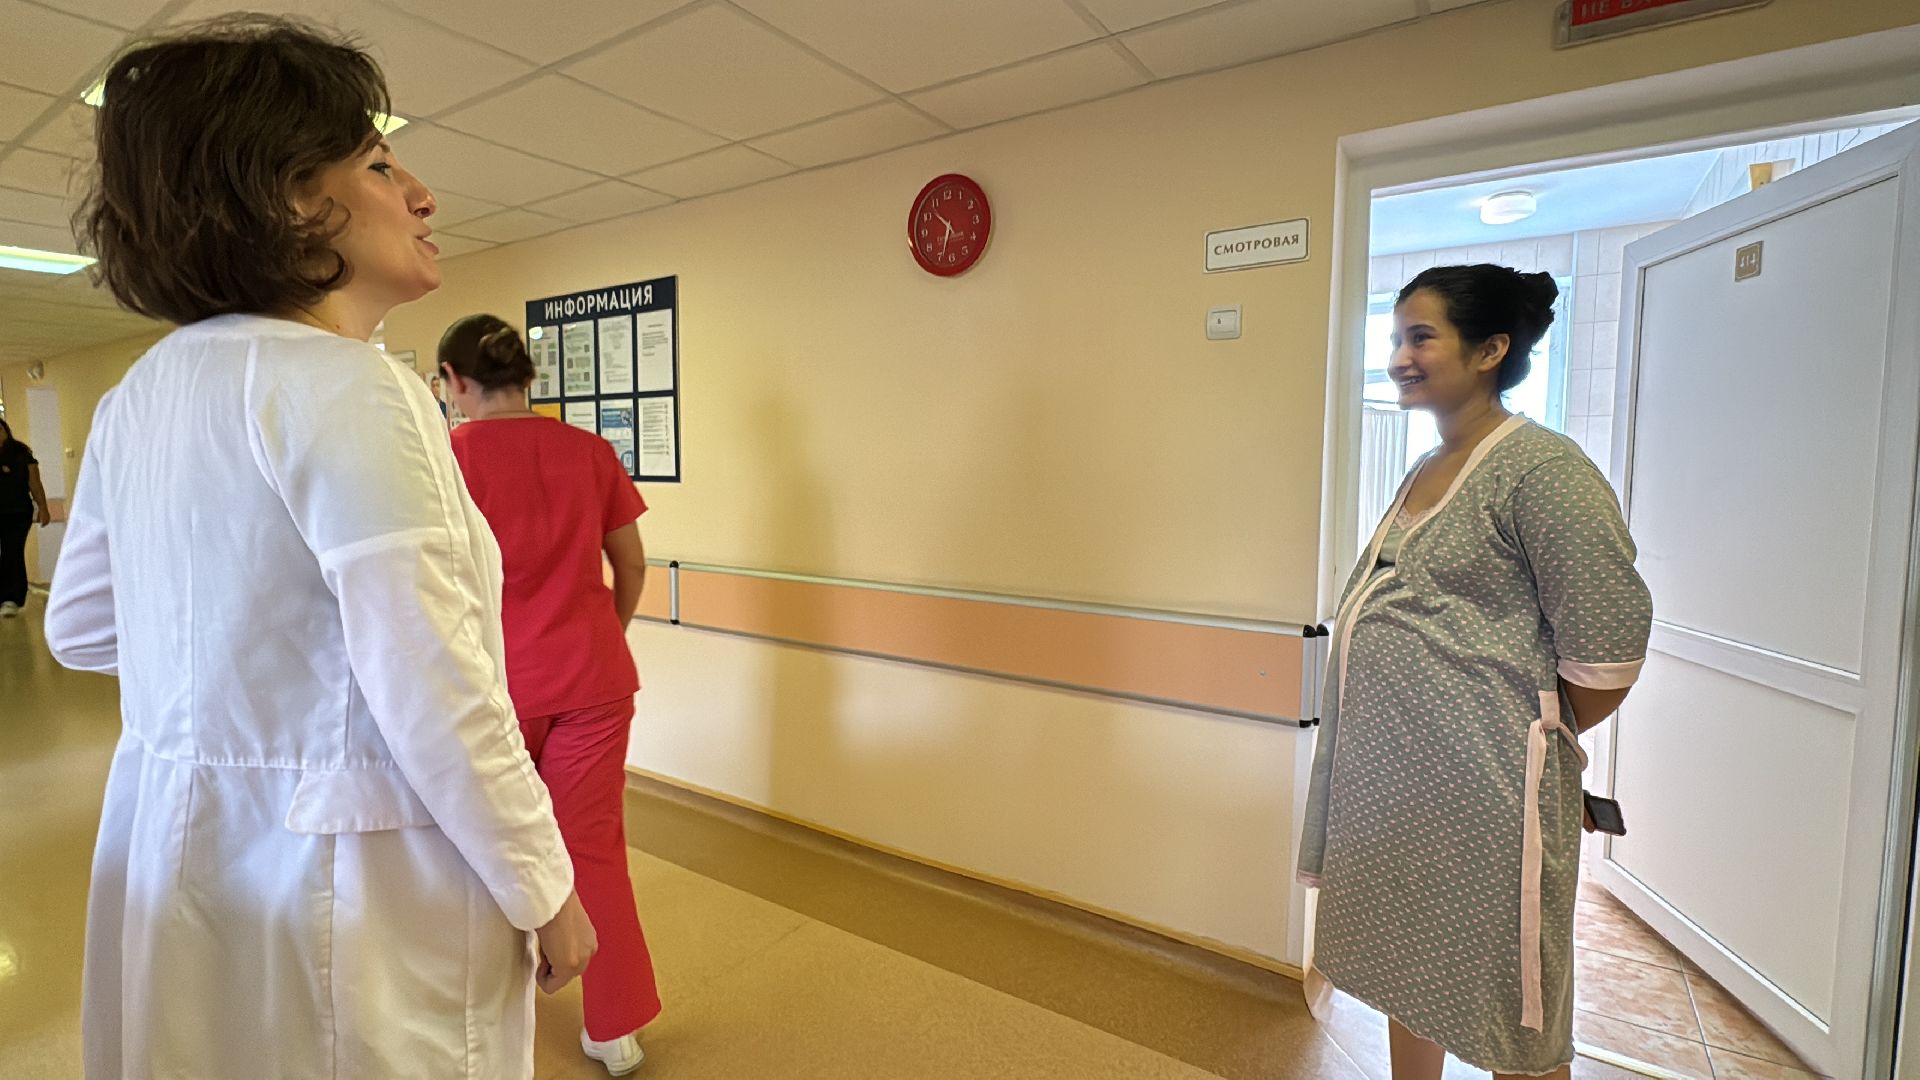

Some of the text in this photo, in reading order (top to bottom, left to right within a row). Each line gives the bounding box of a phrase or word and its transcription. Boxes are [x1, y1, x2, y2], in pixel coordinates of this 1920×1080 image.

[943, 190, 952, 200] 12
[932, 198, 939, 208] 11
[967, 200, 974, 210] 2
[972, 214, 980, 224] 3
[921, 228, 928, 238] 9
[970, 231, 977, 241] 4
[1213, 234, 1299, 255] СМОТРОВАЯ
[961, 245, 968, 255] 5
[937, 252, 943, 261] 7
[948, 253, 955, 263] 6
[545, 285, 653, 320] ИНФОРМАЦИЯ
